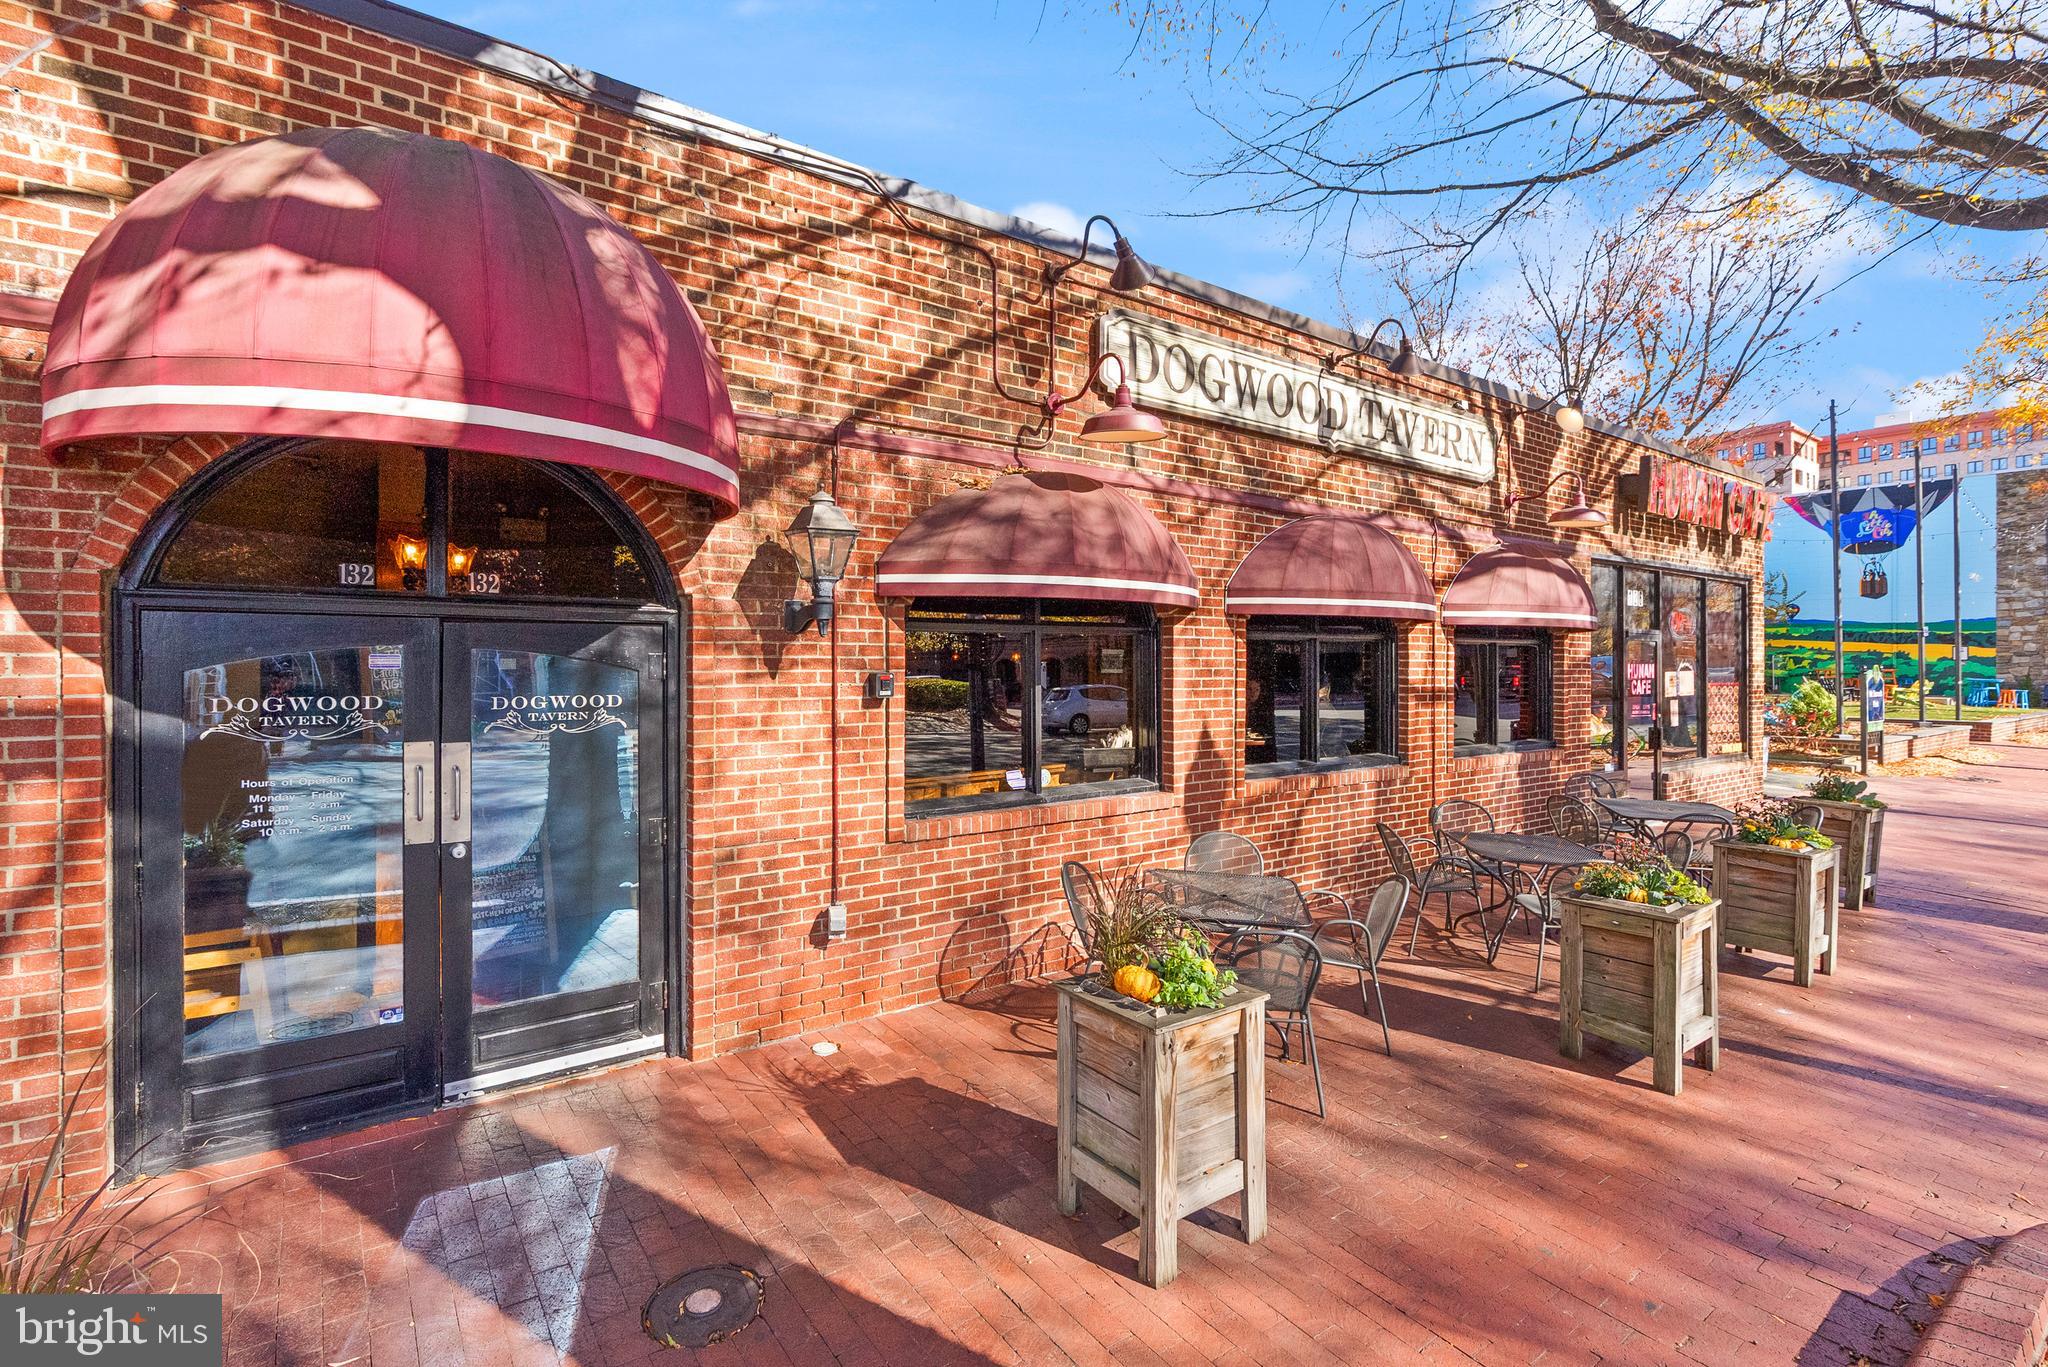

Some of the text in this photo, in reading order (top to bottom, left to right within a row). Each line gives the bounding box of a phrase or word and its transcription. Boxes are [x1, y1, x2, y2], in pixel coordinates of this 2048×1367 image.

[1126, 330, 1486, 466] DOGWOOD TAVERN
[1647, 454, 1724, 530] HUNAN
[338, 563, 376, 586] 132
[468, 572, 501, 594] 132
[1627, 663, 1655, 679] HUNAN
[1631, 679, 1652, 695] CAFE
[209, 695, 383, 714] DOGWOOD
[490, 694, 623, 711] DOGWOOD
[258, 714, 340, 728] TAVERN
[527, 711, 589, 722] TAVERN
[241, 775, 354, 789] Hours of Operation
[248, 792, 296, 804] Monday
[311, 790, 346, 801] Friday
[252, 804, 264, 814] 11
[308, 801, 316, 810] 2
[320, 801, 343, 809] a.m.
[241, 817, 295, 829] Saturday
[311, 812, 353, 823] Sunday
[259, 828, 275, 837] 10
[279, 826, 303, 836] a.m.
[319, 824, 326, 833] 2
[330, 823, 353, 832] a.m.
[502, 888, 532, 899] MUSIC
[472, 909, 504, 921] KITCHEN
[504, 905, 524, 916] OPEN
